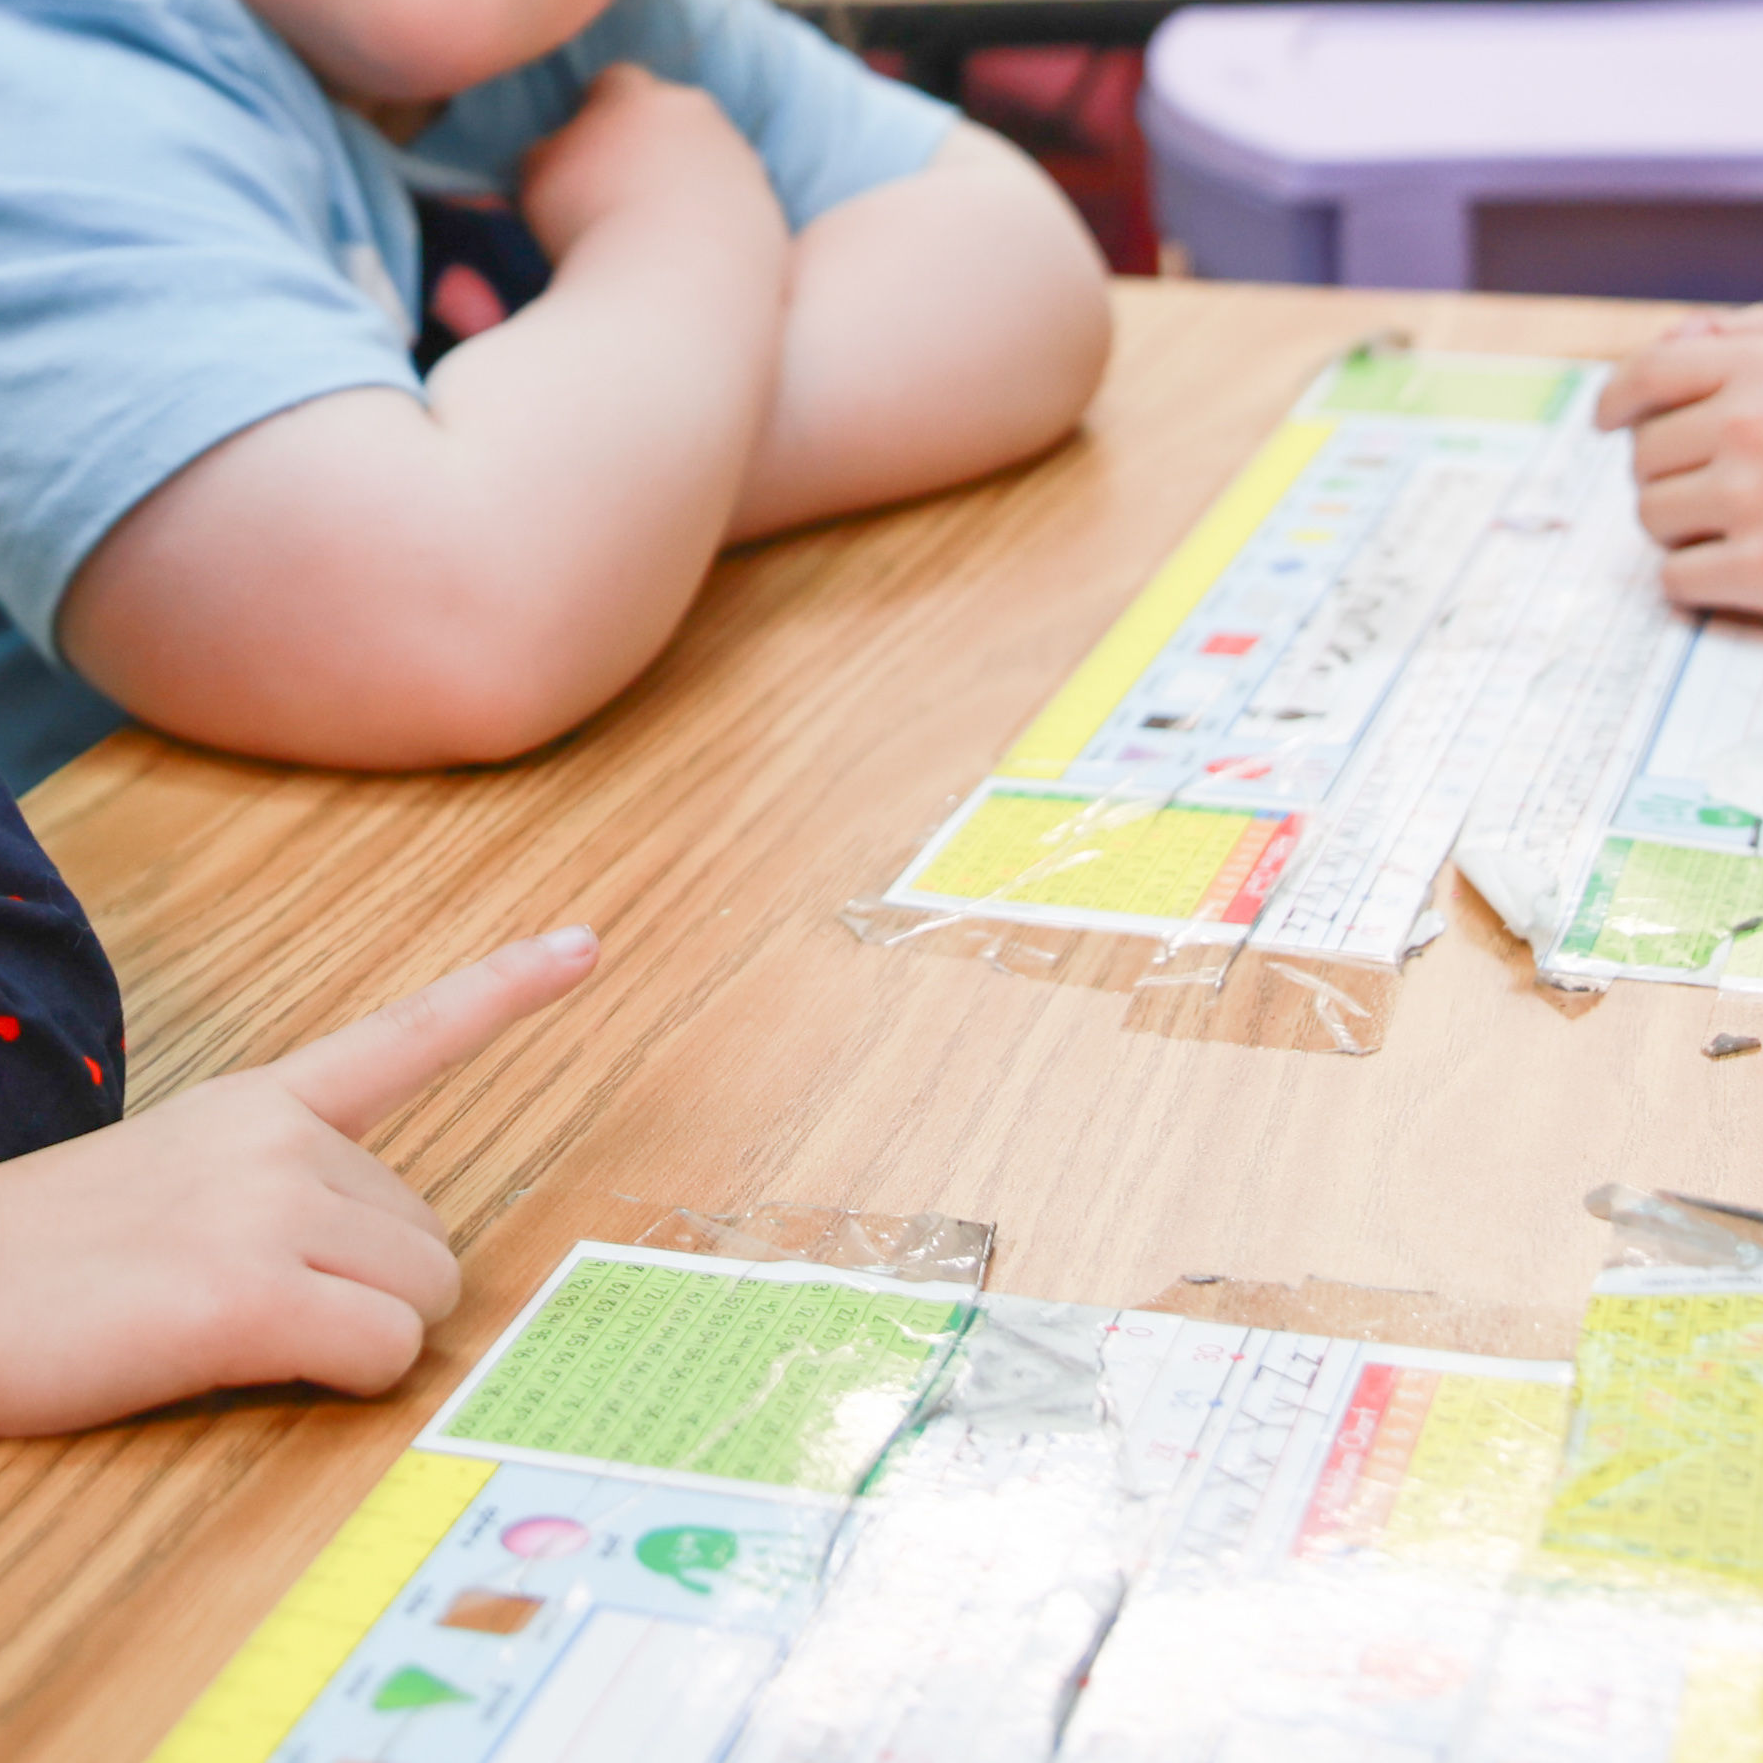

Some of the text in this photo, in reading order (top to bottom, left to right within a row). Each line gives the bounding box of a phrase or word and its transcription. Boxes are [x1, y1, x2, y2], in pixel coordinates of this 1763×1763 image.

[584, 1261, 606, 1271] 91
[622, 1266, 643, 1275] 81
[660, 1270, 680, 1280] 71
[697, 1274, 718, 1284] 61
[569, 1278, 592, 1290] 92
[608, 1283, 630, 1294] 82
[735, 1279, 755, 1290] 51
[770, 1283, 790, 1293] 41
[645, 1287, 667, 1299] 72
[807, 1285, 832, 1297] 31
[556, 1294, 578, 1306] 93
[683, 1292, 705, 1303] 62
[722, 1296, 742, 1308] 52
[595, 1299, 617, 1311] 83
[633, 1304, 654, 1315] 73
[757, 1301, 778, 1312] 42
[796, 1305, 817, 1317] 32
[542, 1311, 564, 1323] 94
[671, 1308, 692, 1320] 63
[709, 1313, 730, 1325] 53
[834, 1310, 855, 1322] 22
[581, 1316, 603, 1328] 84
[619, 1321, 641, 1333] 74
[745, 1318, 766, 1329] 43
[784, 1322, 806, 1334] 33
[528, 1328, 550, 1340] 95
[657, 1326, 679, 1338] 64
[696, 1331, 718, 1343] 54
[822, 1327, 844, 1339] 23
[567, 1334, 589, 1345] 85
[605, 1339, 628, 1350] 75
[733, 1335, 754, 1348] 44
[513, 1346, 536, 1358] 96
[644, 1344, 666, 1356] 65
[684, 1349, 705, 1361] 55
[552, 1351, 576, 1364] 86
[591, 1356, 614, 1369] 76
[720, 1353, 741, 1366] 45
[498, 1364, 522, 1376] 97
[630, 1361, 653, 1374] 66
[670, 1367, 692, 1379] 56
[538, 1369, 561, 1382] 87
[577, 1374, 600, 1387] 77
[707, 1371, 729, 1384] 46
[616, 1380, 639, 1392] 67
[657, 1385, 679, 1398] 57
[694, 1390, 716, 1403] 47
